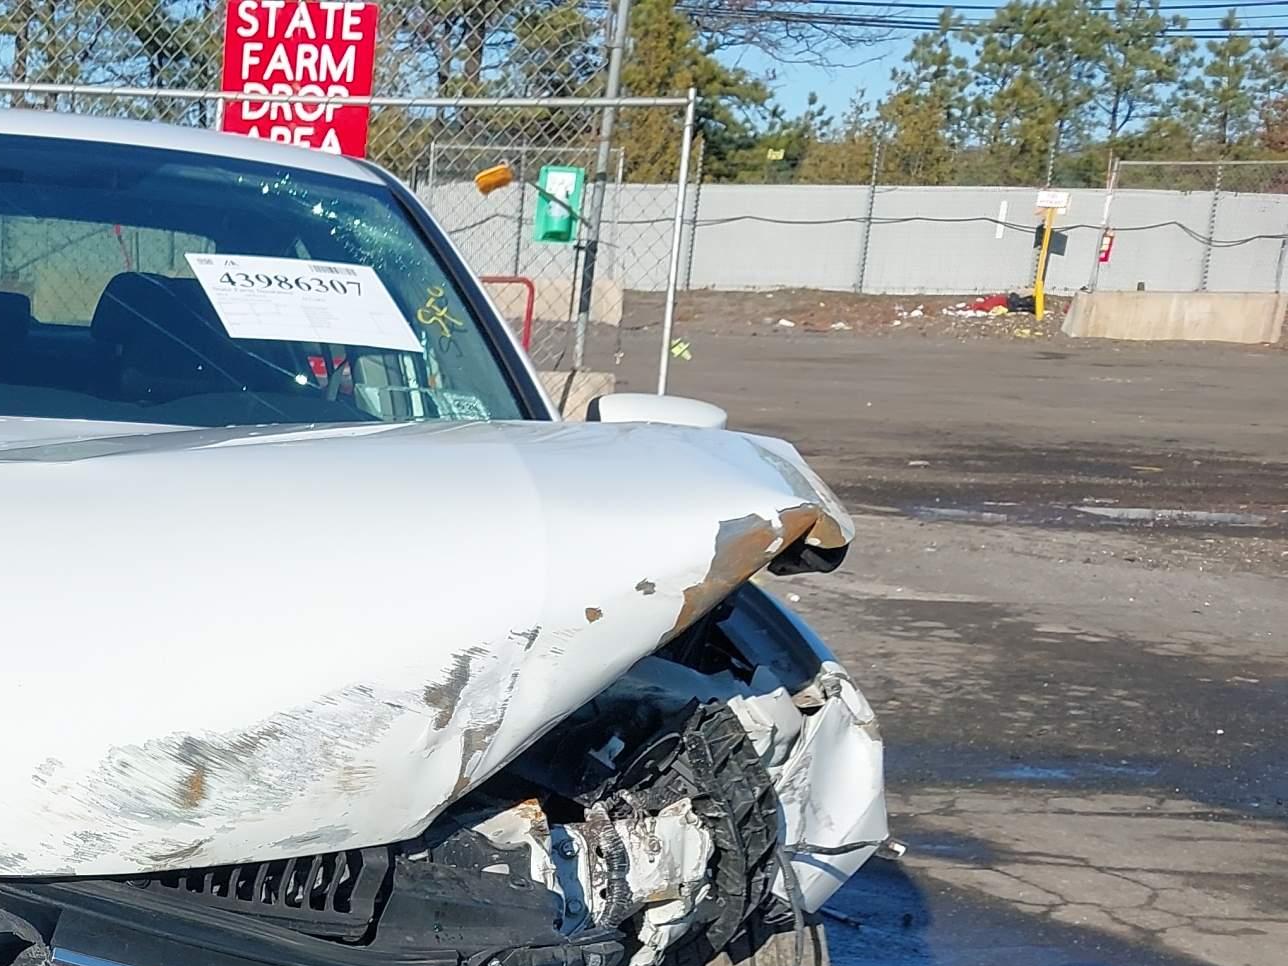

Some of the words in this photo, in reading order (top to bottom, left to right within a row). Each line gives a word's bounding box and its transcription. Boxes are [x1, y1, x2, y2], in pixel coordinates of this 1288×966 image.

[236, 0, 365, 40] STATE
[241, 42, 356, 83] FARM
[241, 82, 349, 123] DROP
[219, 272, 361, 297] 43986307
